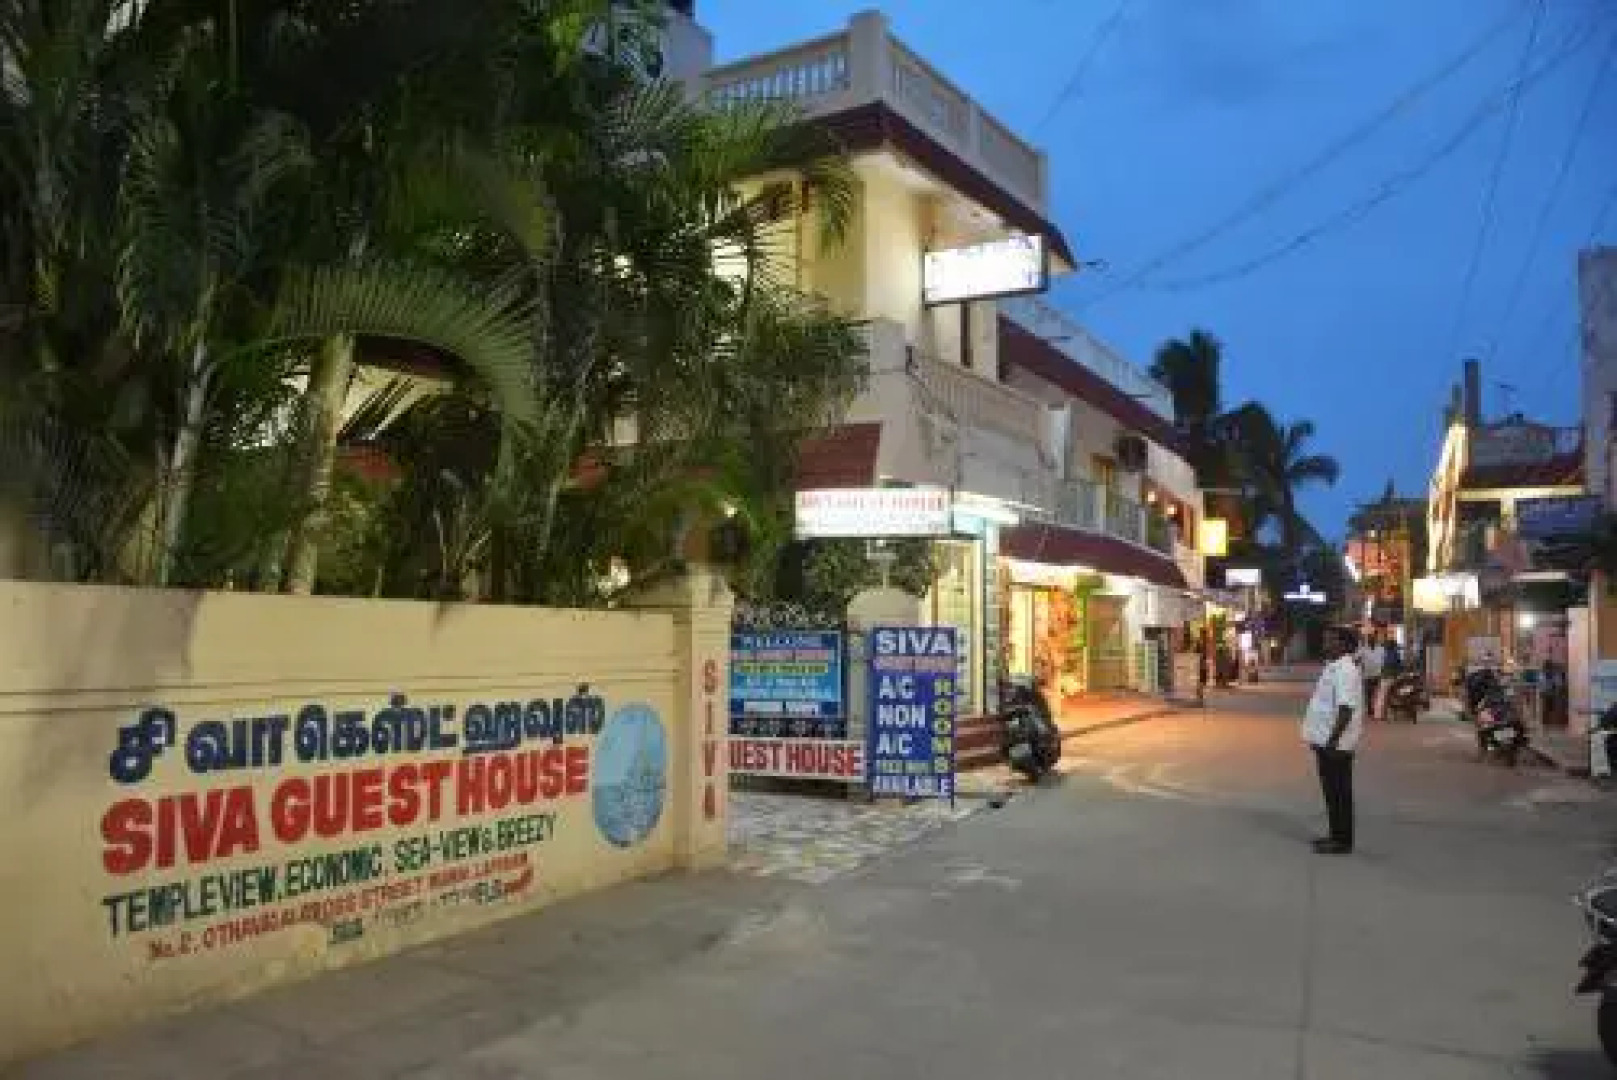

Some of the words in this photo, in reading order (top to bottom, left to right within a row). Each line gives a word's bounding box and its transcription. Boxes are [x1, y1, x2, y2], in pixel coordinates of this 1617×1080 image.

[875, 629, 952, 654] SIVA
[877, 704, 926, 728] NON
[729, 740, 783, 772] UEST
[786, 741, 864, 777] HOUSE
[101, 787, 260, 875] SIVA
[270, 761, 452, 844] GUEST
[454, 746, 589, 820] HOUSE
